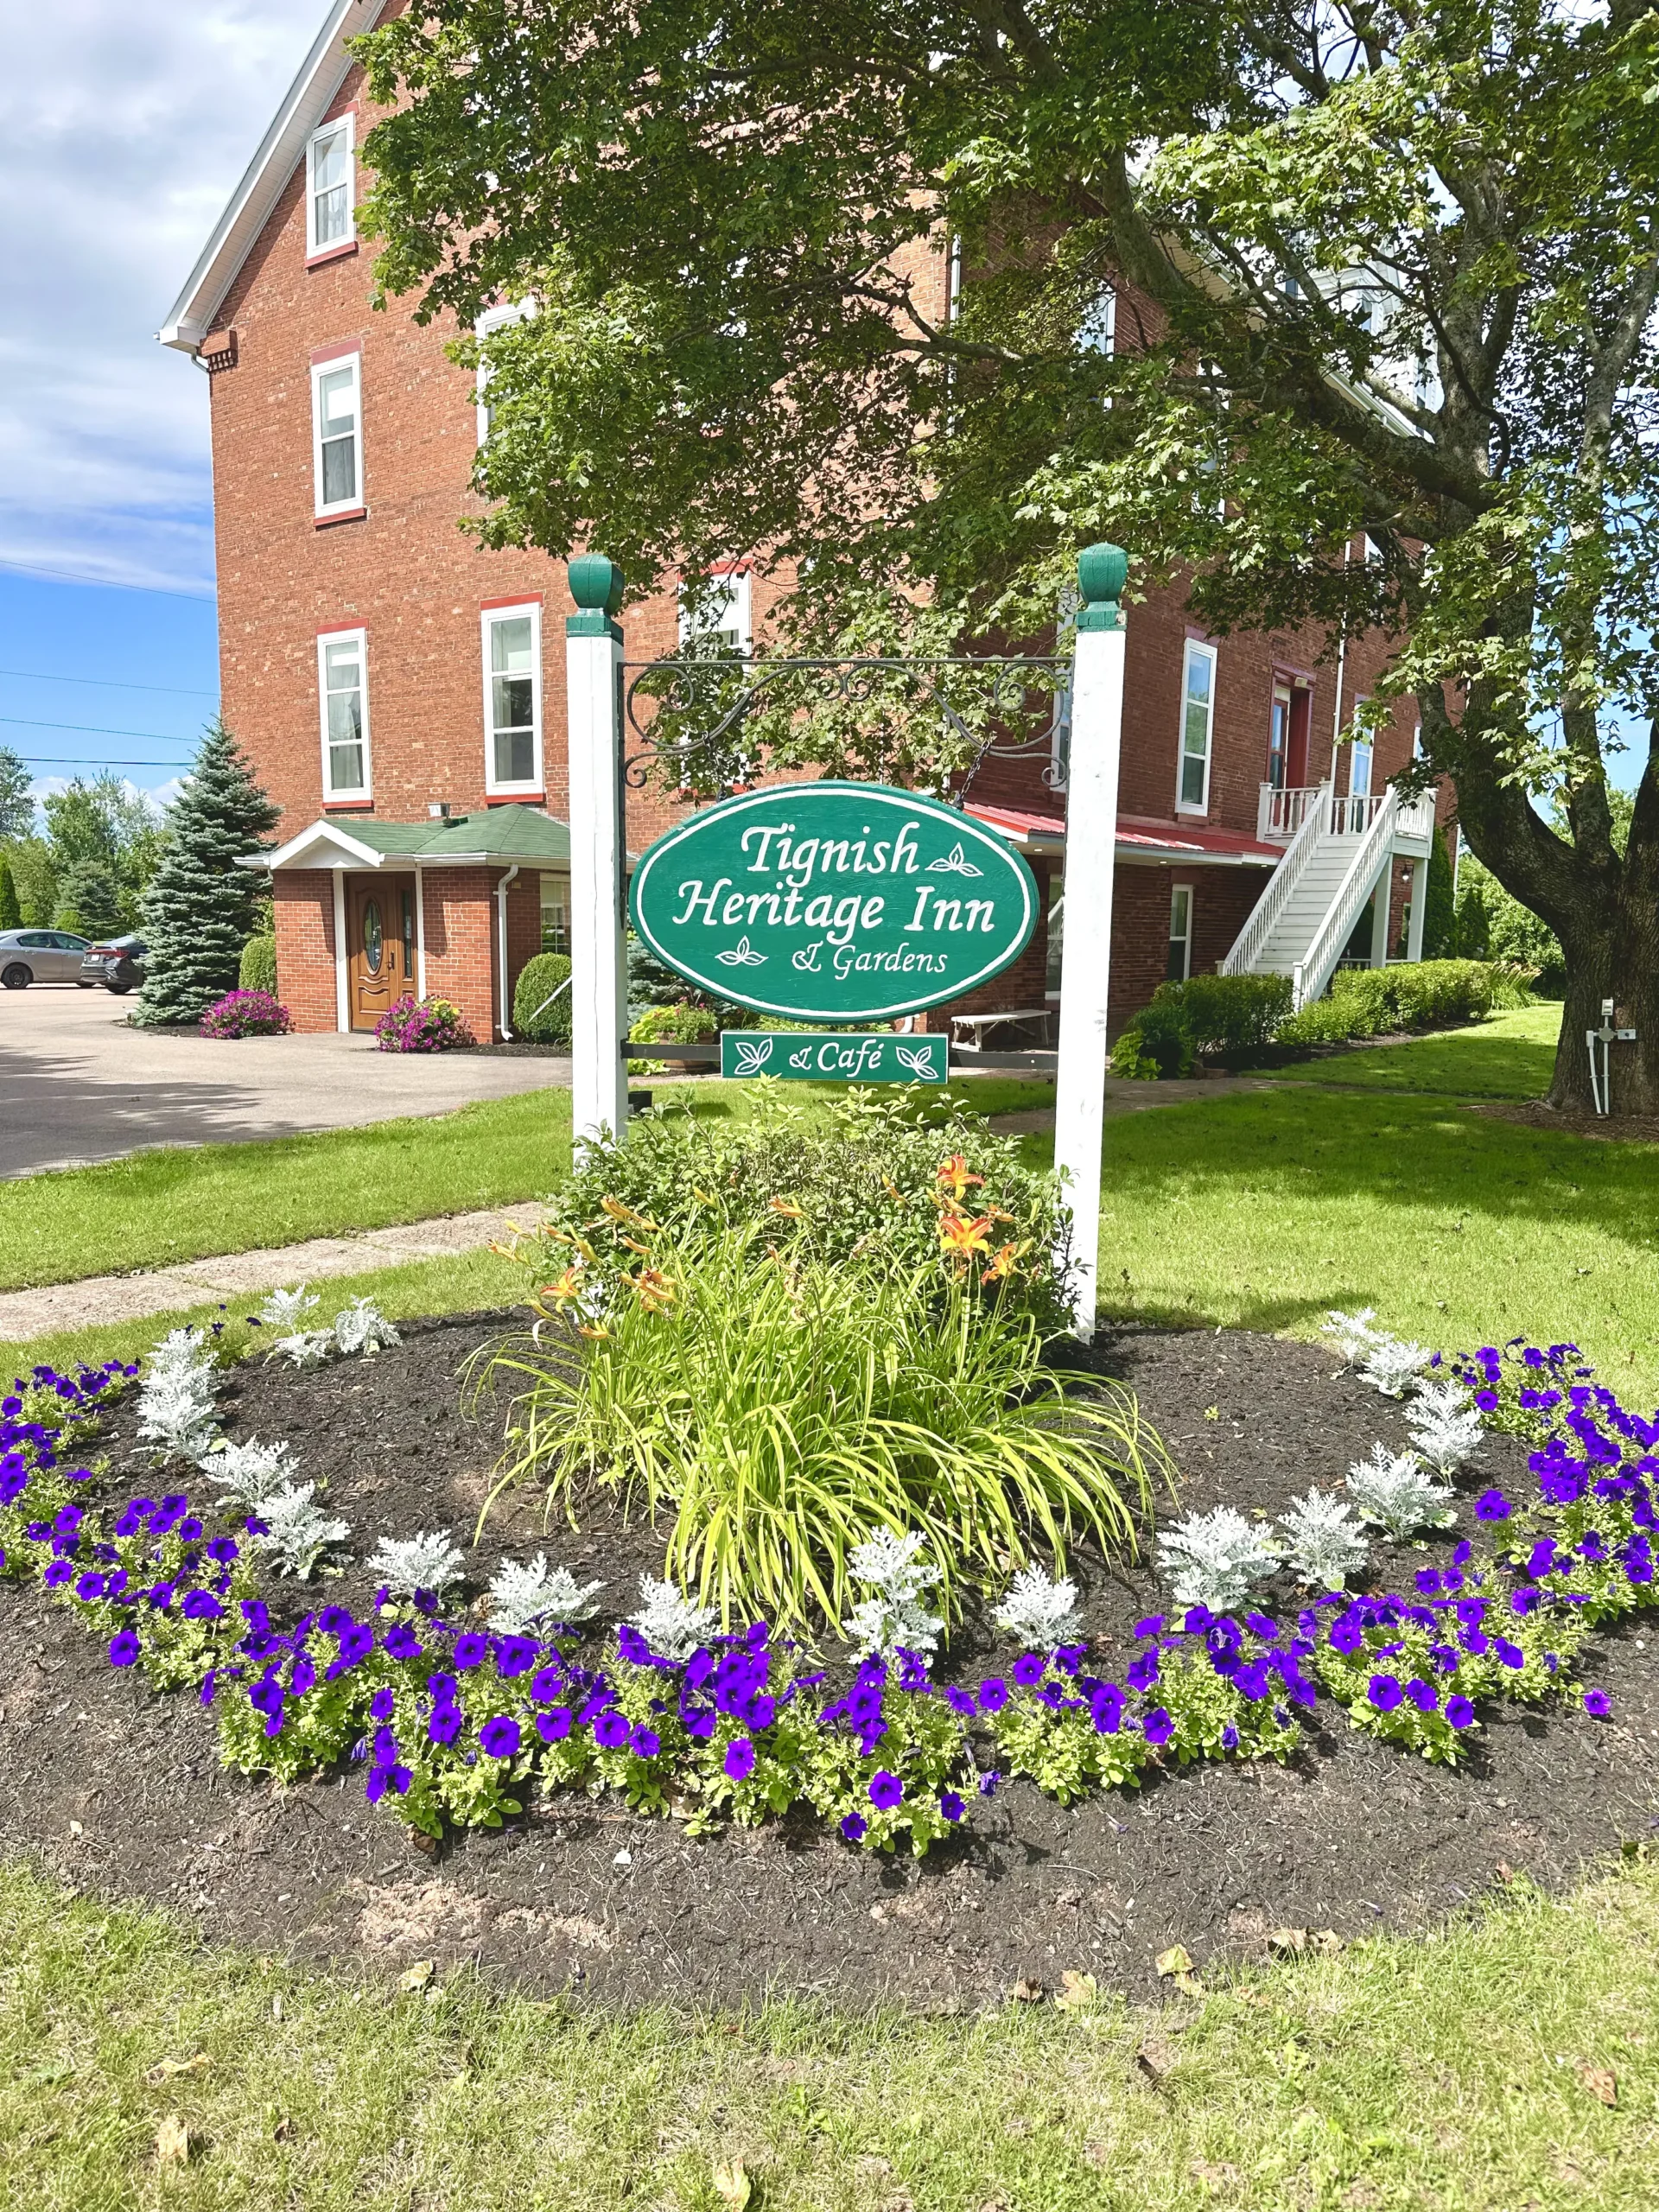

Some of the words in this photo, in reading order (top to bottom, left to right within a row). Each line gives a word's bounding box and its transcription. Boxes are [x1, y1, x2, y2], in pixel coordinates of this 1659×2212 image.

[741, 821, 920, 887] Tignish
[671, 877, 885, 946] Heritage
[903, 886, 995, 932] Inn
[791, 940, 824, 973] &
[832, 943, 949, 981] Gardens
[788, 1045, 813, 1071] &
[817, 1038, 885, 1077] Café
